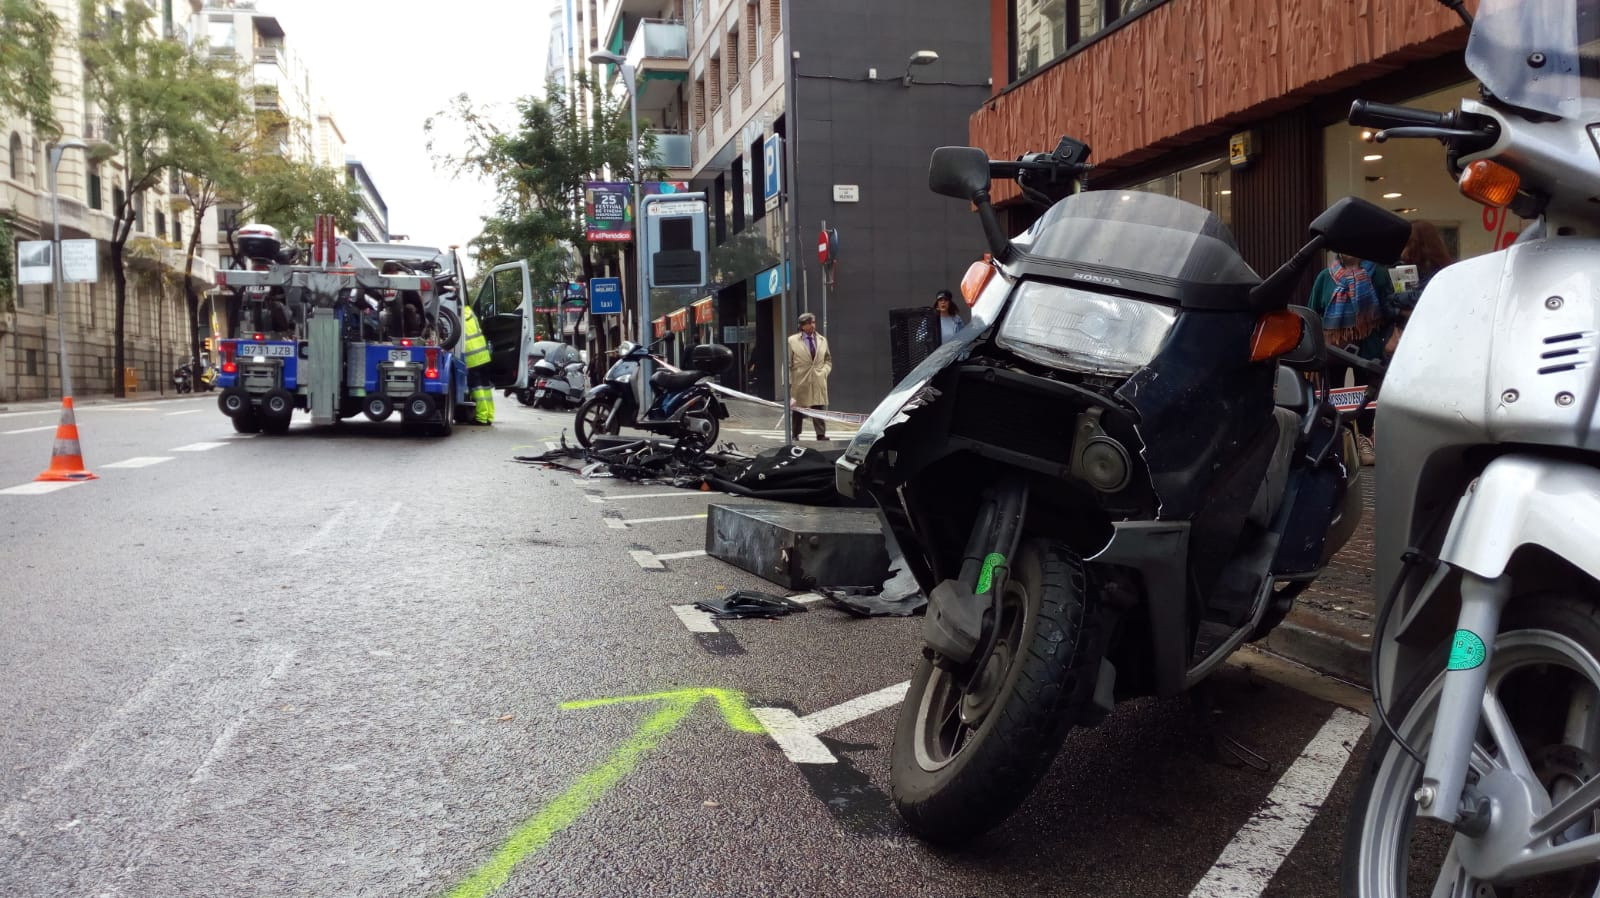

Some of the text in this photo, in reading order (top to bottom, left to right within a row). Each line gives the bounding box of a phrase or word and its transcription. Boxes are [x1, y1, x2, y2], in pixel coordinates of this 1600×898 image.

[766, 145, 775, 193] P
[601, 194, 617, 205] 25
[1072, 273, 1121, 287] HONDA
[600, 299, 613, 308] taxi
[272, 347, 291, 356] JZB
